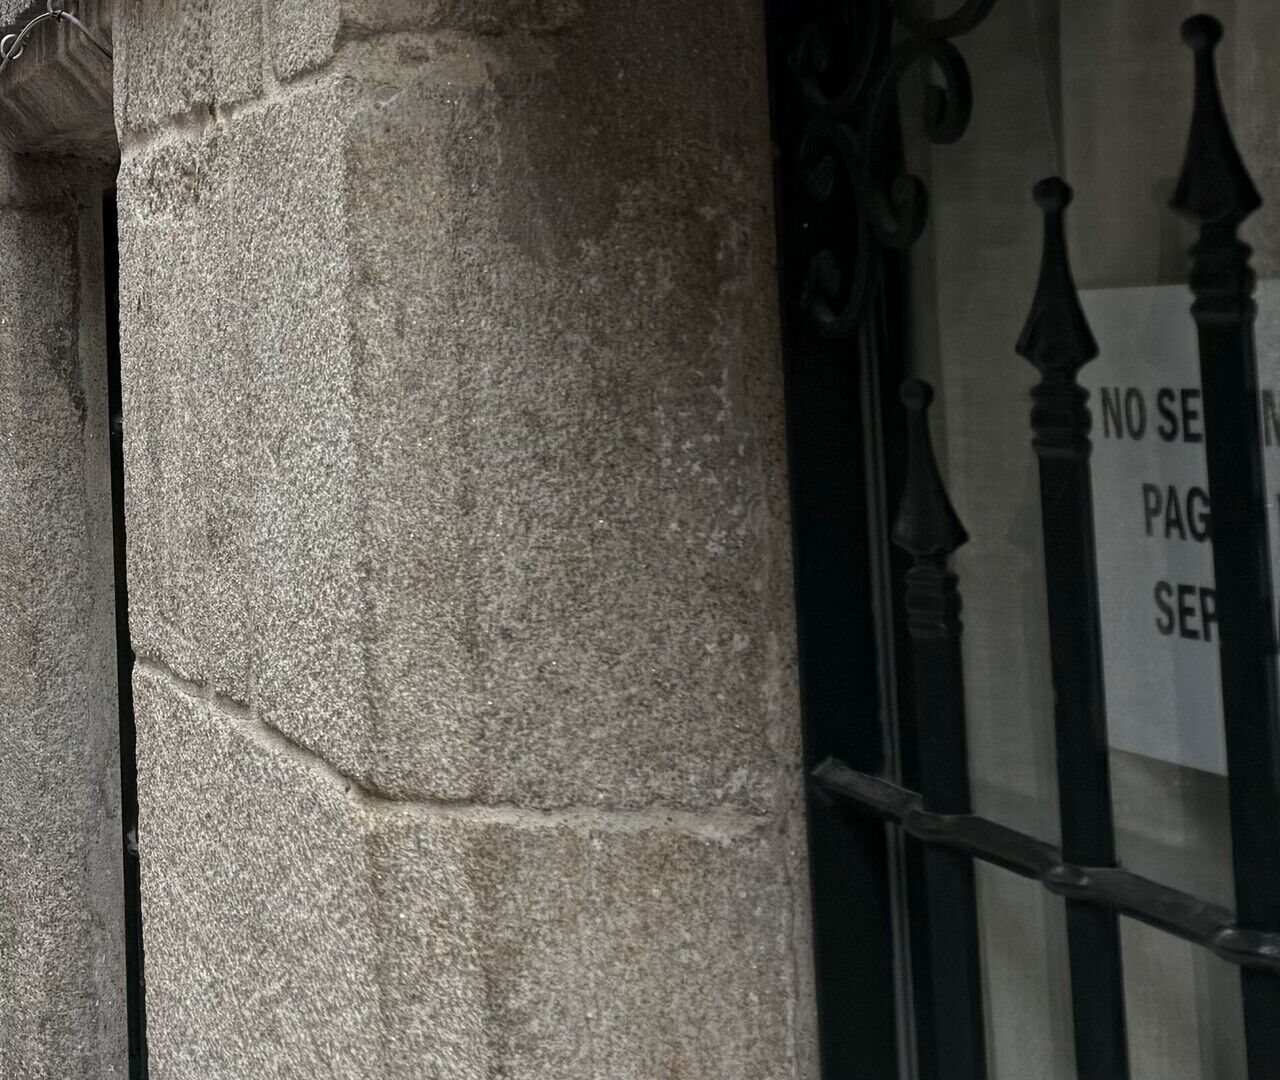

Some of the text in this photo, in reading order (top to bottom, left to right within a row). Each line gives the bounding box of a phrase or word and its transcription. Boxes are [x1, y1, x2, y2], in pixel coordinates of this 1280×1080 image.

[1100, 386, 1147, 441] NO
[1142, 482, 1213, 542] PAG
[1154, 580, 1219, 643] SEP
